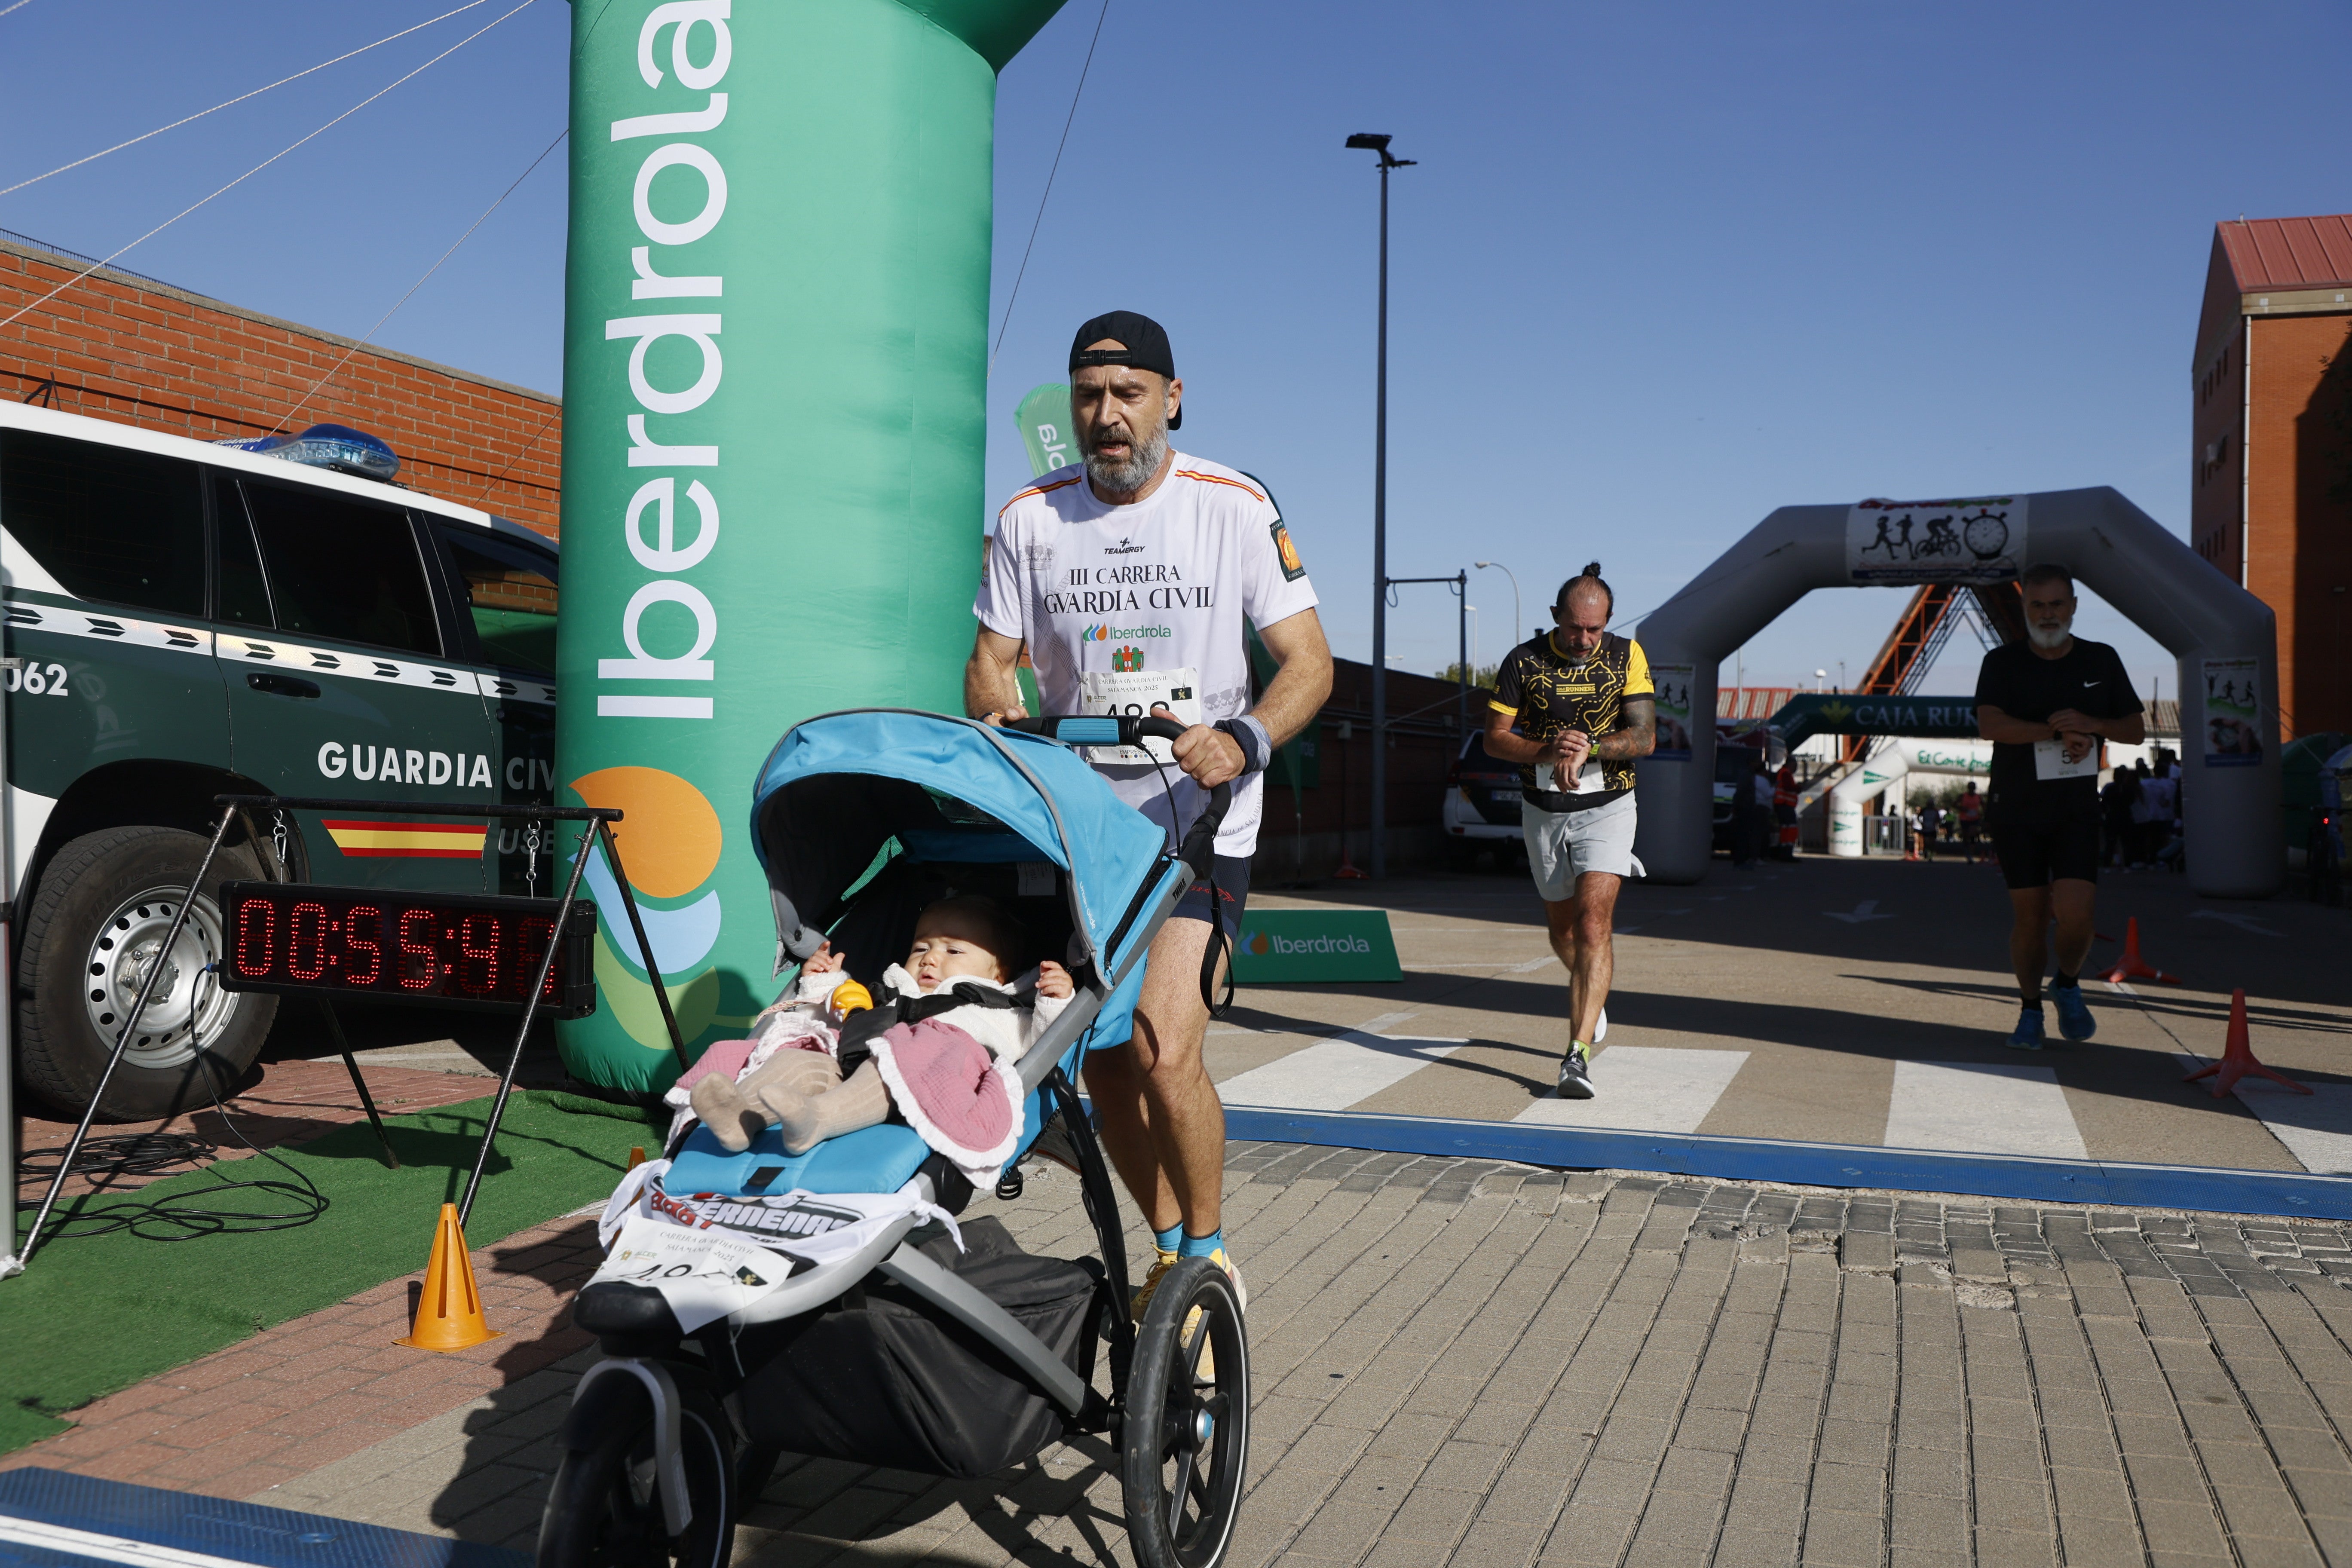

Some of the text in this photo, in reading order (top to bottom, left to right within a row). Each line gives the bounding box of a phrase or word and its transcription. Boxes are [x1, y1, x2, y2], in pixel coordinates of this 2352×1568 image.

[597, 0, 732, 719] Iberdrola
[1104, 546, 1145, 555] TEAMERGY
[1069, 564, 1182, 585] III CARRERA
[1044, 587, 1214, 615] GVARDIA CIVIL
[1110, 624, 1172, 640] Iberdrola
[4, 662, 68, 696] 062
[1855, 705, 1919, 730] CAJA
[318, 741, 493, 787] GUARDIA
[1245, 793, 1263, 827] SALAMANCA
[1172, 878, 1187, 901] THULE
[1272, 935, 1370, 954] Iberdrola
[659, 1231, 697, 1244] CARRERA
[665, 1243, 735, 1262] SALAMANCA 2025
